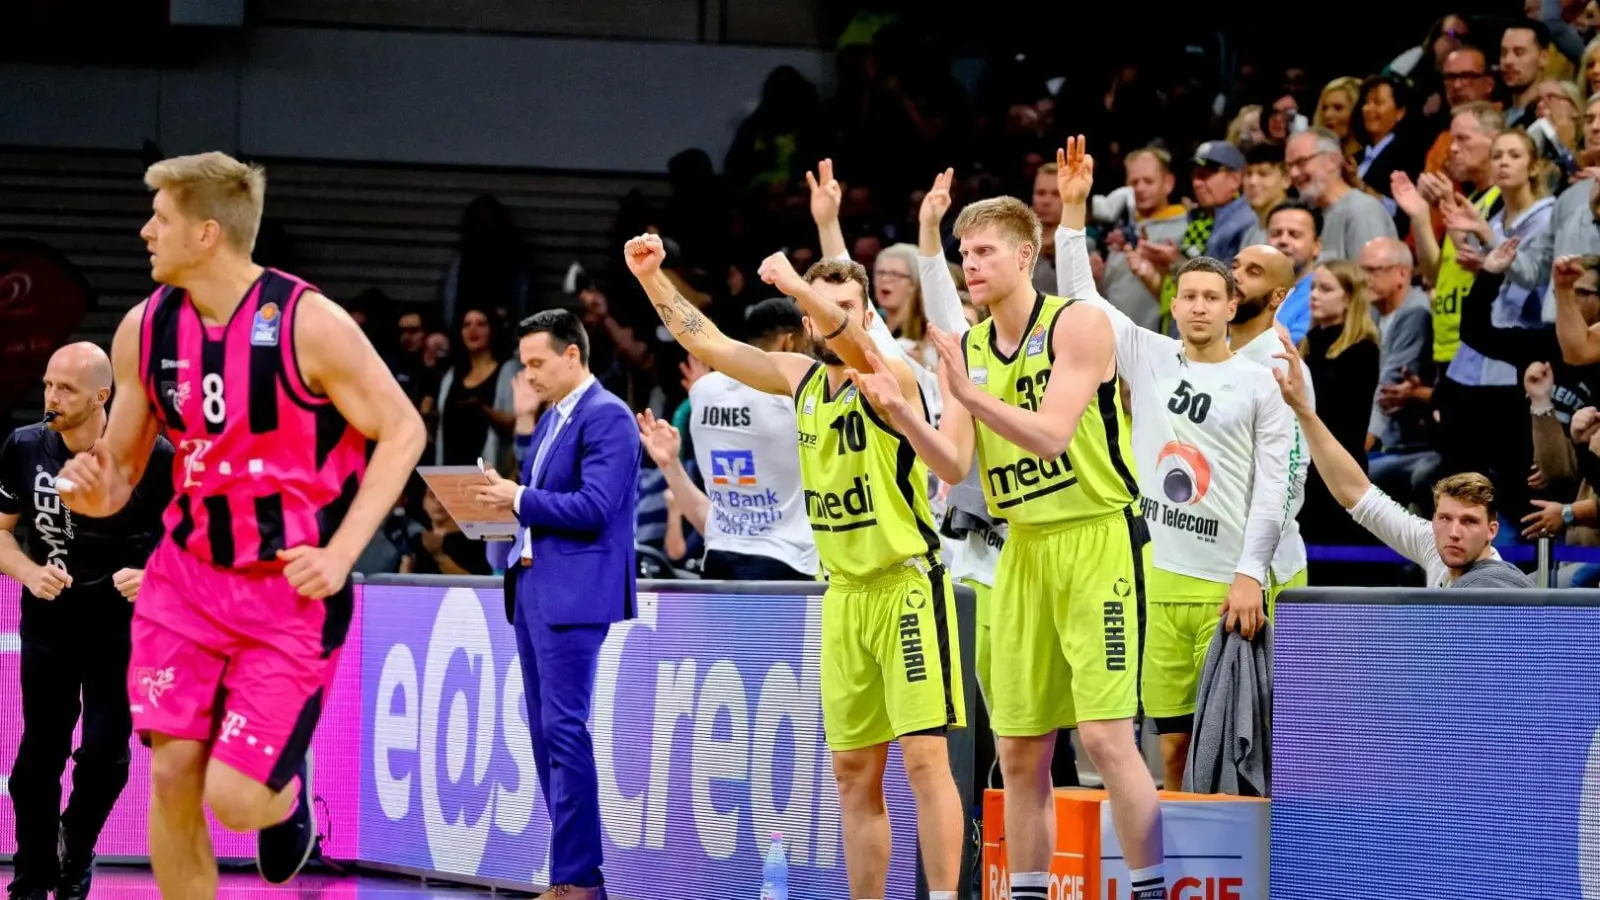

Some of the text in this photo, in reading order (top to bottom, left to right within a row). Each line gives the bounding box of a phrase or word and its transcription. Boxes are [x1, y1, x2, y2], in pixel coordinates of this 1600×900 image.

[1431, 287, 1468, 314] ed
[202, 372, 226, 424] 8
[701, 406, 752, 427] JONES
[1167, 379, 1212, 424] 50
[830, 410, 866, 456] 10
[728, 488, 779, 508] Bank
[804, 473, 875, 520] medi
[1139, 495, 1219, 537] HFO Telecom
[900, 612, 928, 684] REHAU
[1103, 601, 1127, 672] REHAU
